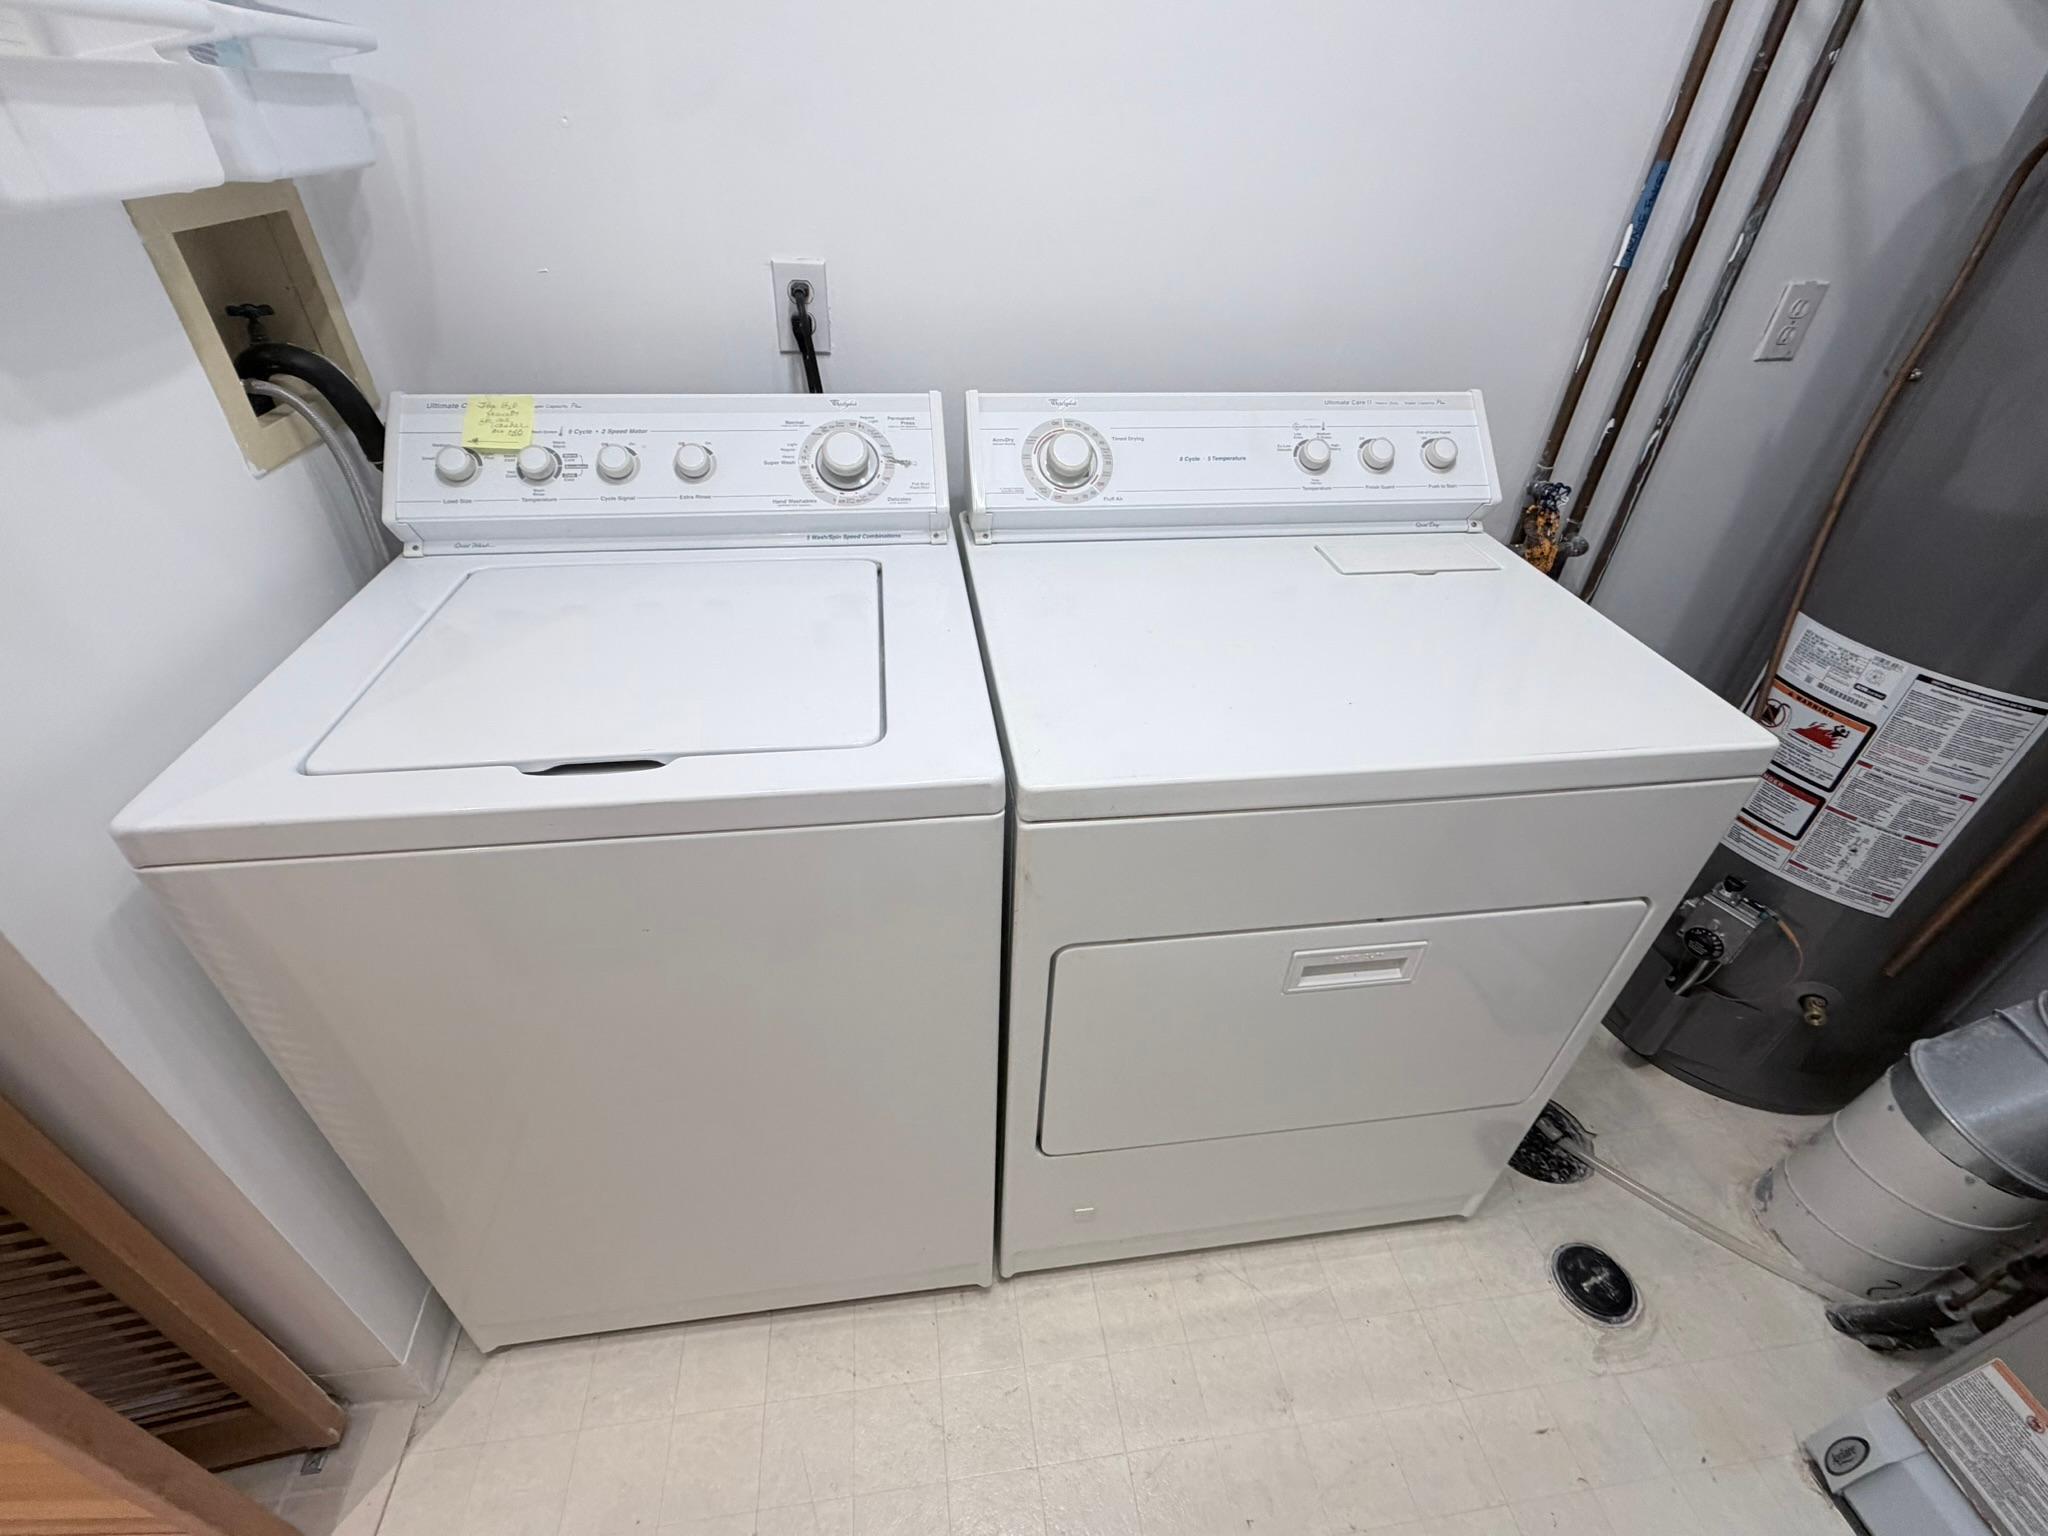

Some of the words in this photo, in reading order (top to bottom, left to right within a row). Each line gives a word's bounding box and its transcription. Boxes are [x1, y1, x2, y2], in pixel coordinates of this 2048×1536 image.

[426, 402, 459, 410] Ultimate
[573, 428, 593, 436] Cycle
[607, 428, 628, 436] Speed
[600, 495, 617, 503] Cycle
[811, 533, 842, 541] Wash/Spin
[862, 532, 902, 540] Combinations
[1796, 694, 1835, 719] WARNING
